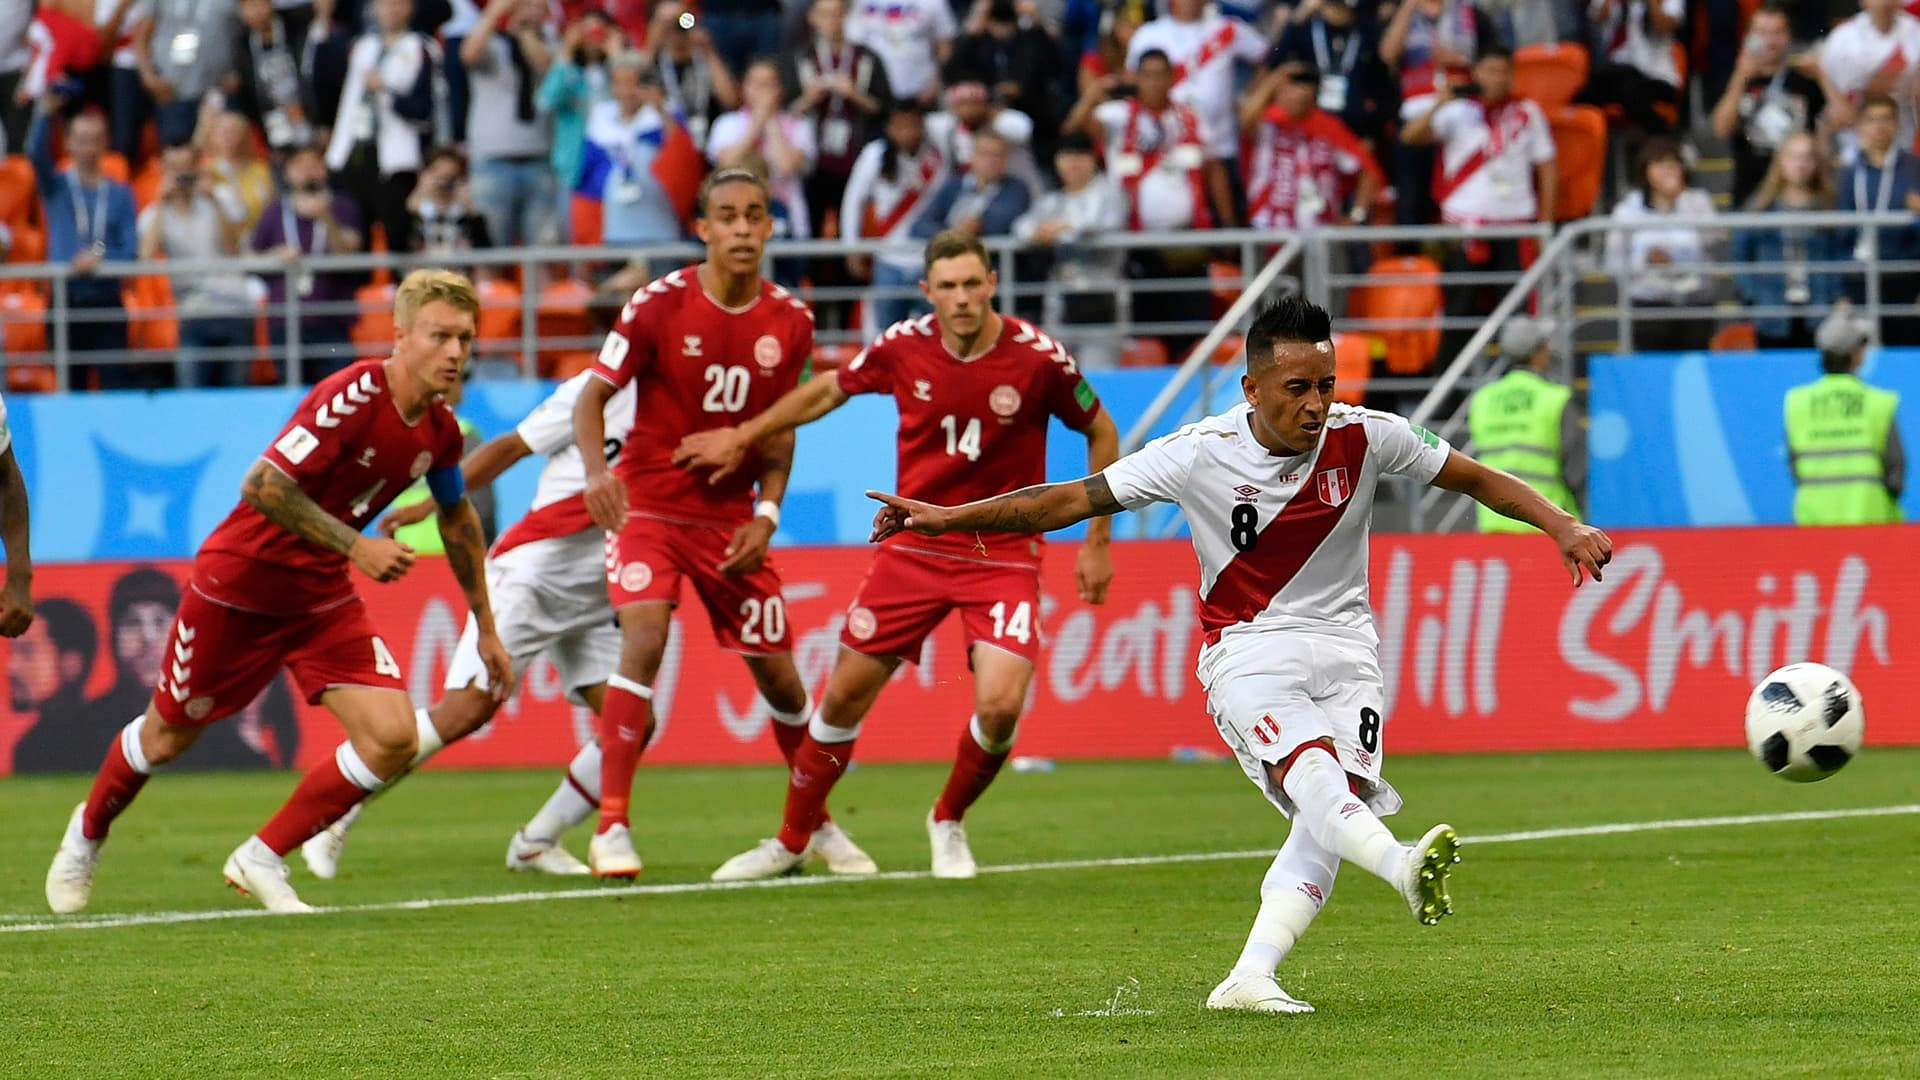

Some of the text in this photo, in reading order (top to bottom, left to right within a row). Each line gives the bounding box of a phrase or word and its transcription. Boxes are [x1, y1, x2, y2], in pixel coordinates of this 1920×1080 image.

[703, 363, 751, 413] 20
[940, 414, 982, 462] 14
[1234, 495, 1258, 504] umbro
[1230, 503, 1259, 552] 8
[740, 596, 786, 645] 20
[989, 600, 1031, 645] 14
[1024, 585, 1199, 716] eat
[1557, 542, 1892, 722] Smith
[371, 635, 402, 680] 4
[1358, 706, 1381, 755] 8
